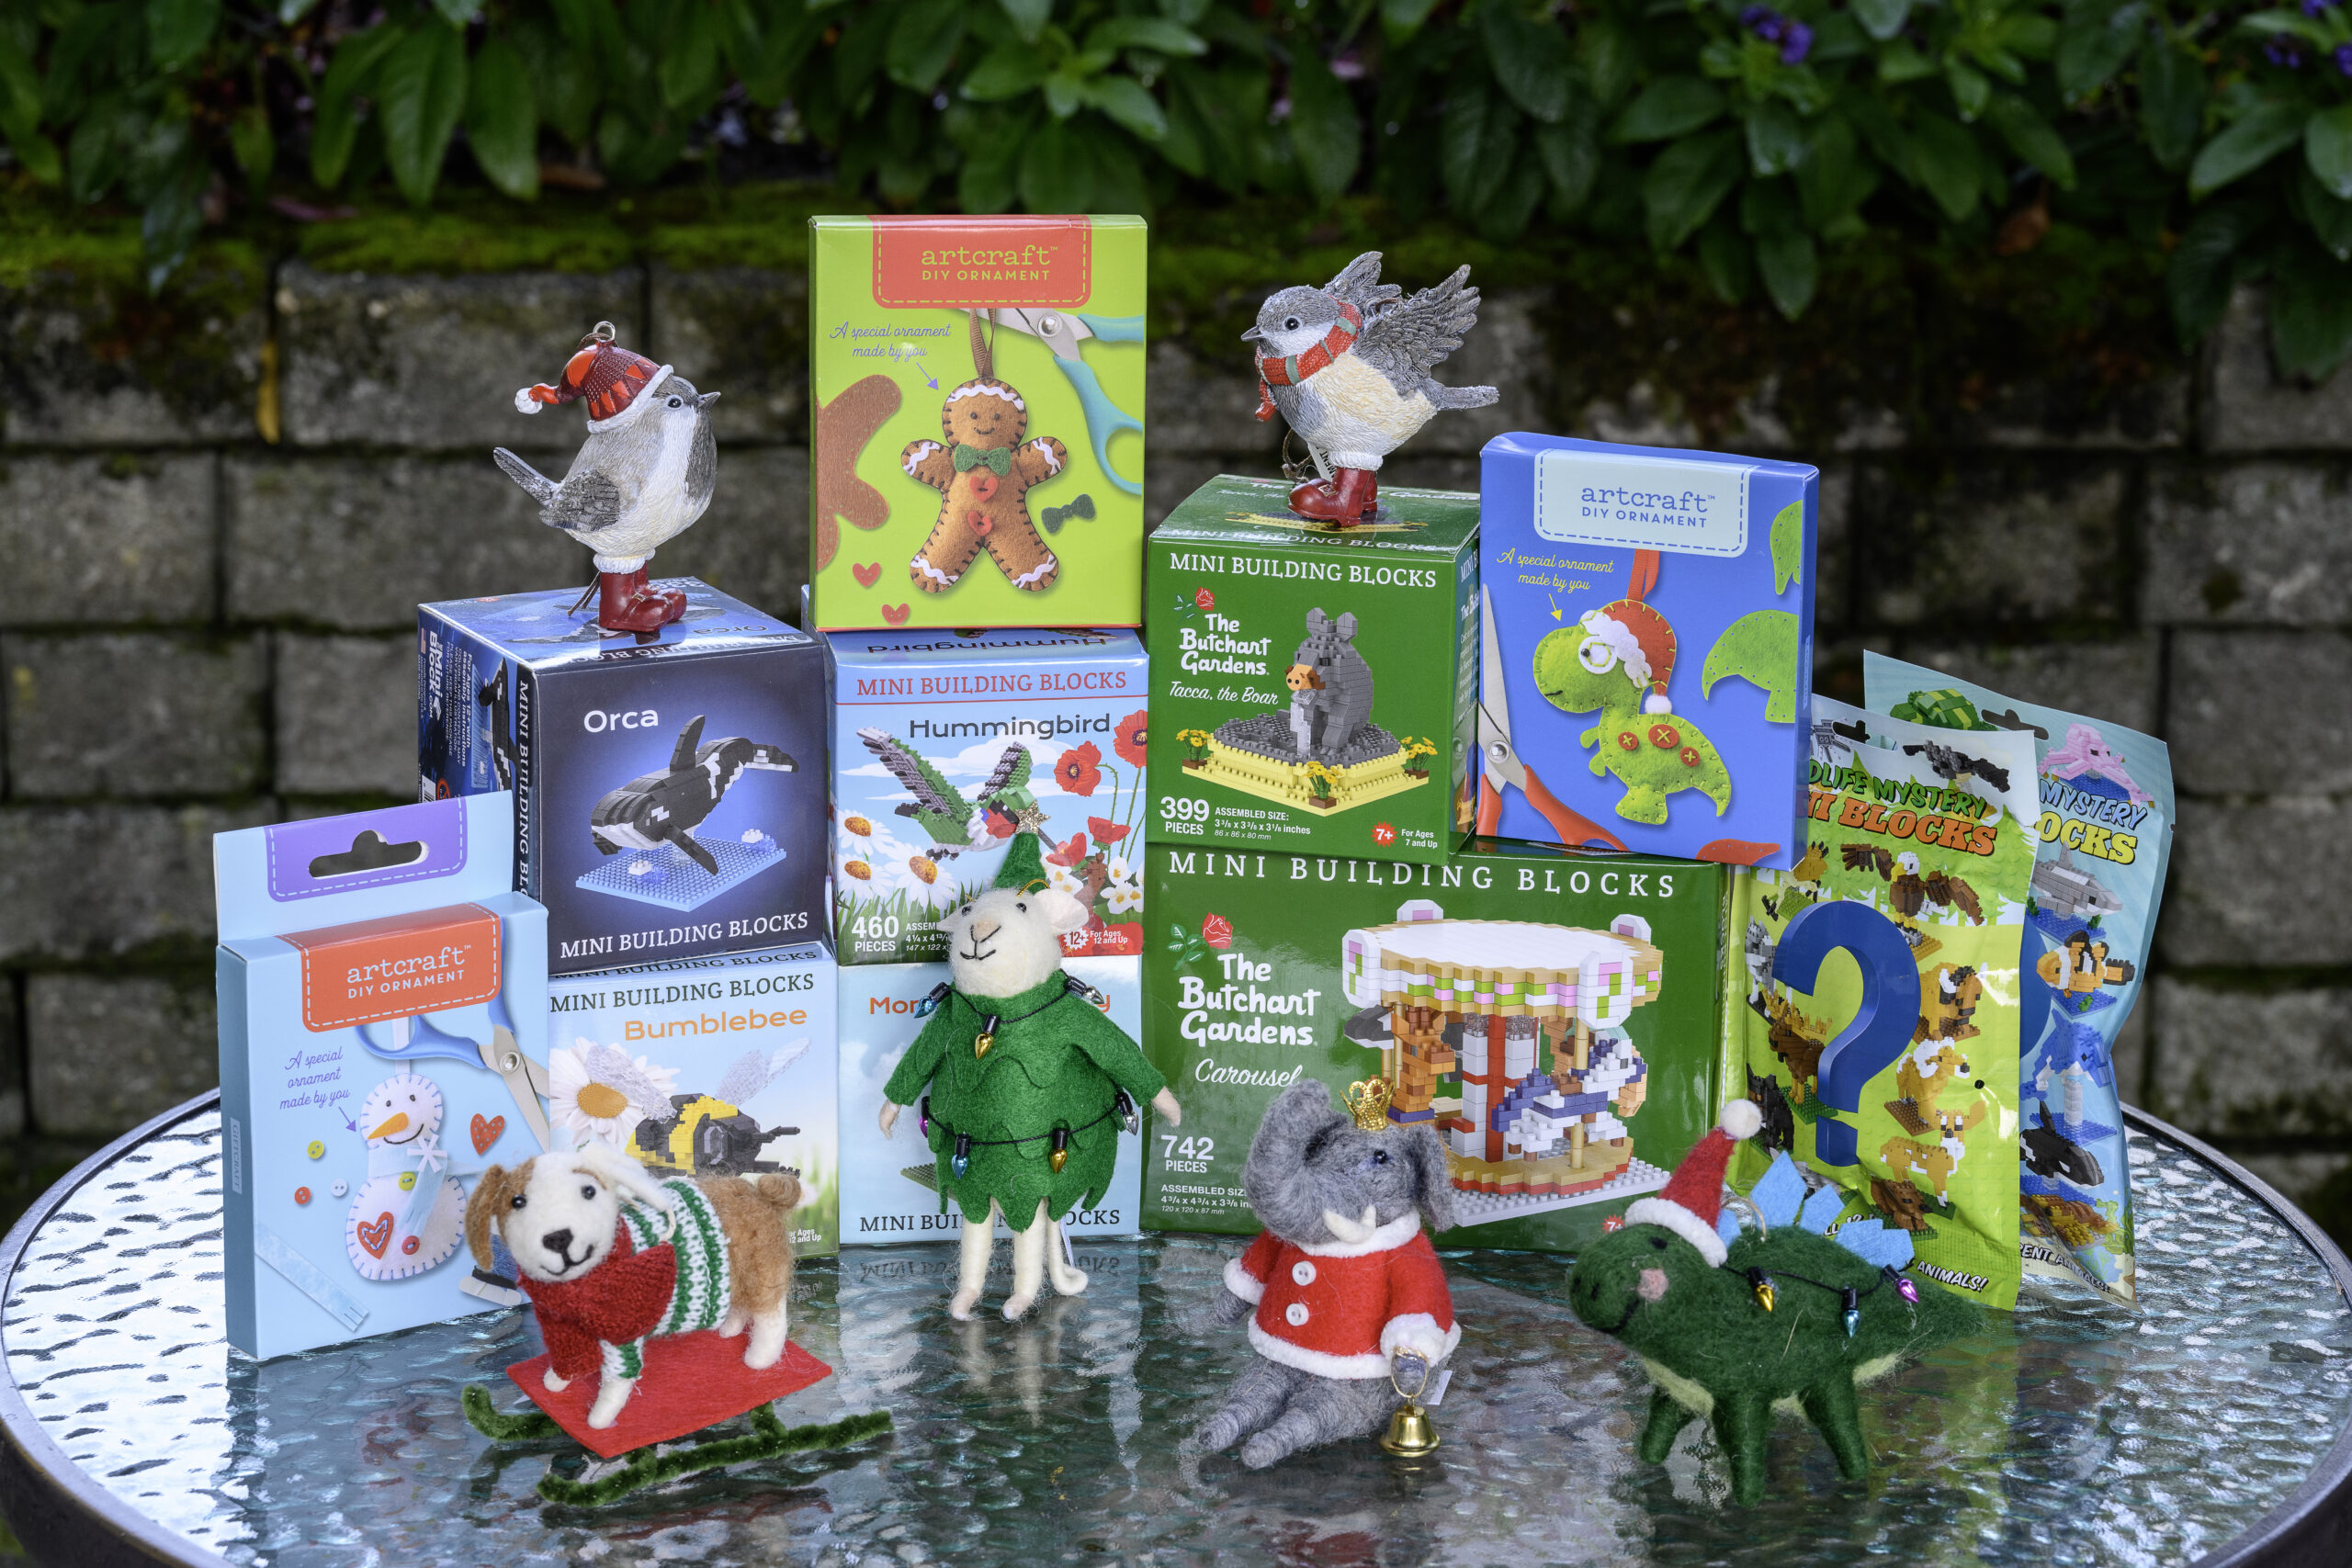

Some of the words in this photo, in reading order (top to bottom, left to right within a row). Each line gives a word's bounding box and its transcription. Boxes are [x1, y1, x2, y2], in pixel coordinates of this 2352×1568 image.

[922, 270, 950, 281] DIY
[956, 270, 1050, 281] ORNAMENT
[829, 321, 849, 339] A
[851, 322, 891, 341] special
[893, 322, 951, 337] ornament
[852, 343, 886, 357] made
[888, 343, 902, 363] by
[903, 344, 928, 363] you
[1581, 506, 1609, 519] DIY
[1615, 509, 1707, 528] ORNAMENT
[1170, 552, 1225, 574] MINI
[1231, 556, 1342, 582] BUILDING
[1349, 564, 1437, 588] BLOCKS
[1497, 547, 1516, 565] A
[1517, 554, 1557, 569] special
[1557, 558, 1614, 573] ornament
[1518, 572, 1551, 586] made
[1552, 573, 1567, 593] by
[1567, 580, 1590, 593] you
[1204, 613, 1240, 634] The
[866, 637, 1108, 654] Hummingbird
[1179, 627, 1272, 657] Butchart
[856, 677, 914, 696] MINI
[920, 673, 1033, 694] BUILDING
[1039, 671, 1127, 692] BLOCKS
[1169, 681, 1214, 702] Tacca,
[1217, 686, 1239, 703] the
[1241, 687, 1279, 705] Boar
[519, 680, 529, 739] MINI
[583, 708, 660, 734] Orca
[910, 713, 1111, 740] Hummingbird
[1809, 759, 1868, 795] DLIFE
[1873, 776, 1988, 819] MYSTERY
[1159, 795, 1210, 822] 399
[1215, 807, 1266, 820] ASSEMBLED
[1267, 809, 1290, 821] SIZE:
[2039, 778, 2147, 831] MYSTERY
[1165, 821, 1204, 836] PIECES
[1214, 829, 1225, 838] 86
[1231, 830, 1240, 839] 86
[1248, 831, 1257, 840] 80
[1283, 824, 1311, 835] inches
[1375, 828, 1394, 841] 7+
[1401, 829, 1414, 838] For
[1415, 829, 1434, 840] Ages
[1838, 796, 1997, 857] BLOCKS
[2033, 810, 2138, 865] OCKS
[1405, 838, 1410, 847] 7
[1411, 839, 1426, 848] and
[1427, 840, 1438, 850] Up
[1169, 851, 1265, 878] MINI
[1290, 856, 1493, 889] BUILDING
[1517, 868, 1675, 897] BLOCKS
[560, 935, 613, 959] MINI
[620, 924, 723, 952] BUILDING
[729, 910, 808, 939] BLOCKS
[851, 915, 899, 939] 460
[905, 921, 937, 931] ASSEM
[1102, 930, 1122, 938] Ages
[854, 940, 897, 953] PIECES
[1069, 931, 1086, 945] 12+
[1118, 936, 1128, 944] Up
[610, 959, 725, 976] BUILDING
[729, 951, 818, 966] BLOCKS
[1216, 953, 1272, 982] The
[348, 985, 374, 999] DIY
[379, 969, 464, 993] ORNAMENT
[550, 992, 606, 1013] MINI
[613, 981, 723, 1009] BUILDING
[729, 973, 814, 999] BLOCKS
[1177, 976, 1322, 1016] Butchart
[625, 1009, 808, 1042] Bumblebee
[285, 1050, 302, 1070] A
[305, 1045, 344, 1069] special
[288, 1066, 341, 1089] ornament
[1194, 1057, 1303, 1088] Carousel
[279, 1091, 311, 1110] made
[313, 1089, 328, 1109] by
[328, 1089, 351, 1107] you
[1160, 1134, 1215, 1161] 742
[1165, 1159, 1208, 1174] PIECES
[1160, 1184, 1226, 1196] ASSEMBLED
[1227, 1188, 1247, 1197] SIZ
[859, 1216, 914, 1232] MINI
[1065, 1209, 1121, 1226] OCKS
[797, 1228, 815, 1237] Ages
[797, 1235, 810, 1243] and
[811, 1234, 822, 1243] Up
[1917, 1259, 1989, 1293] ANIMALS!
